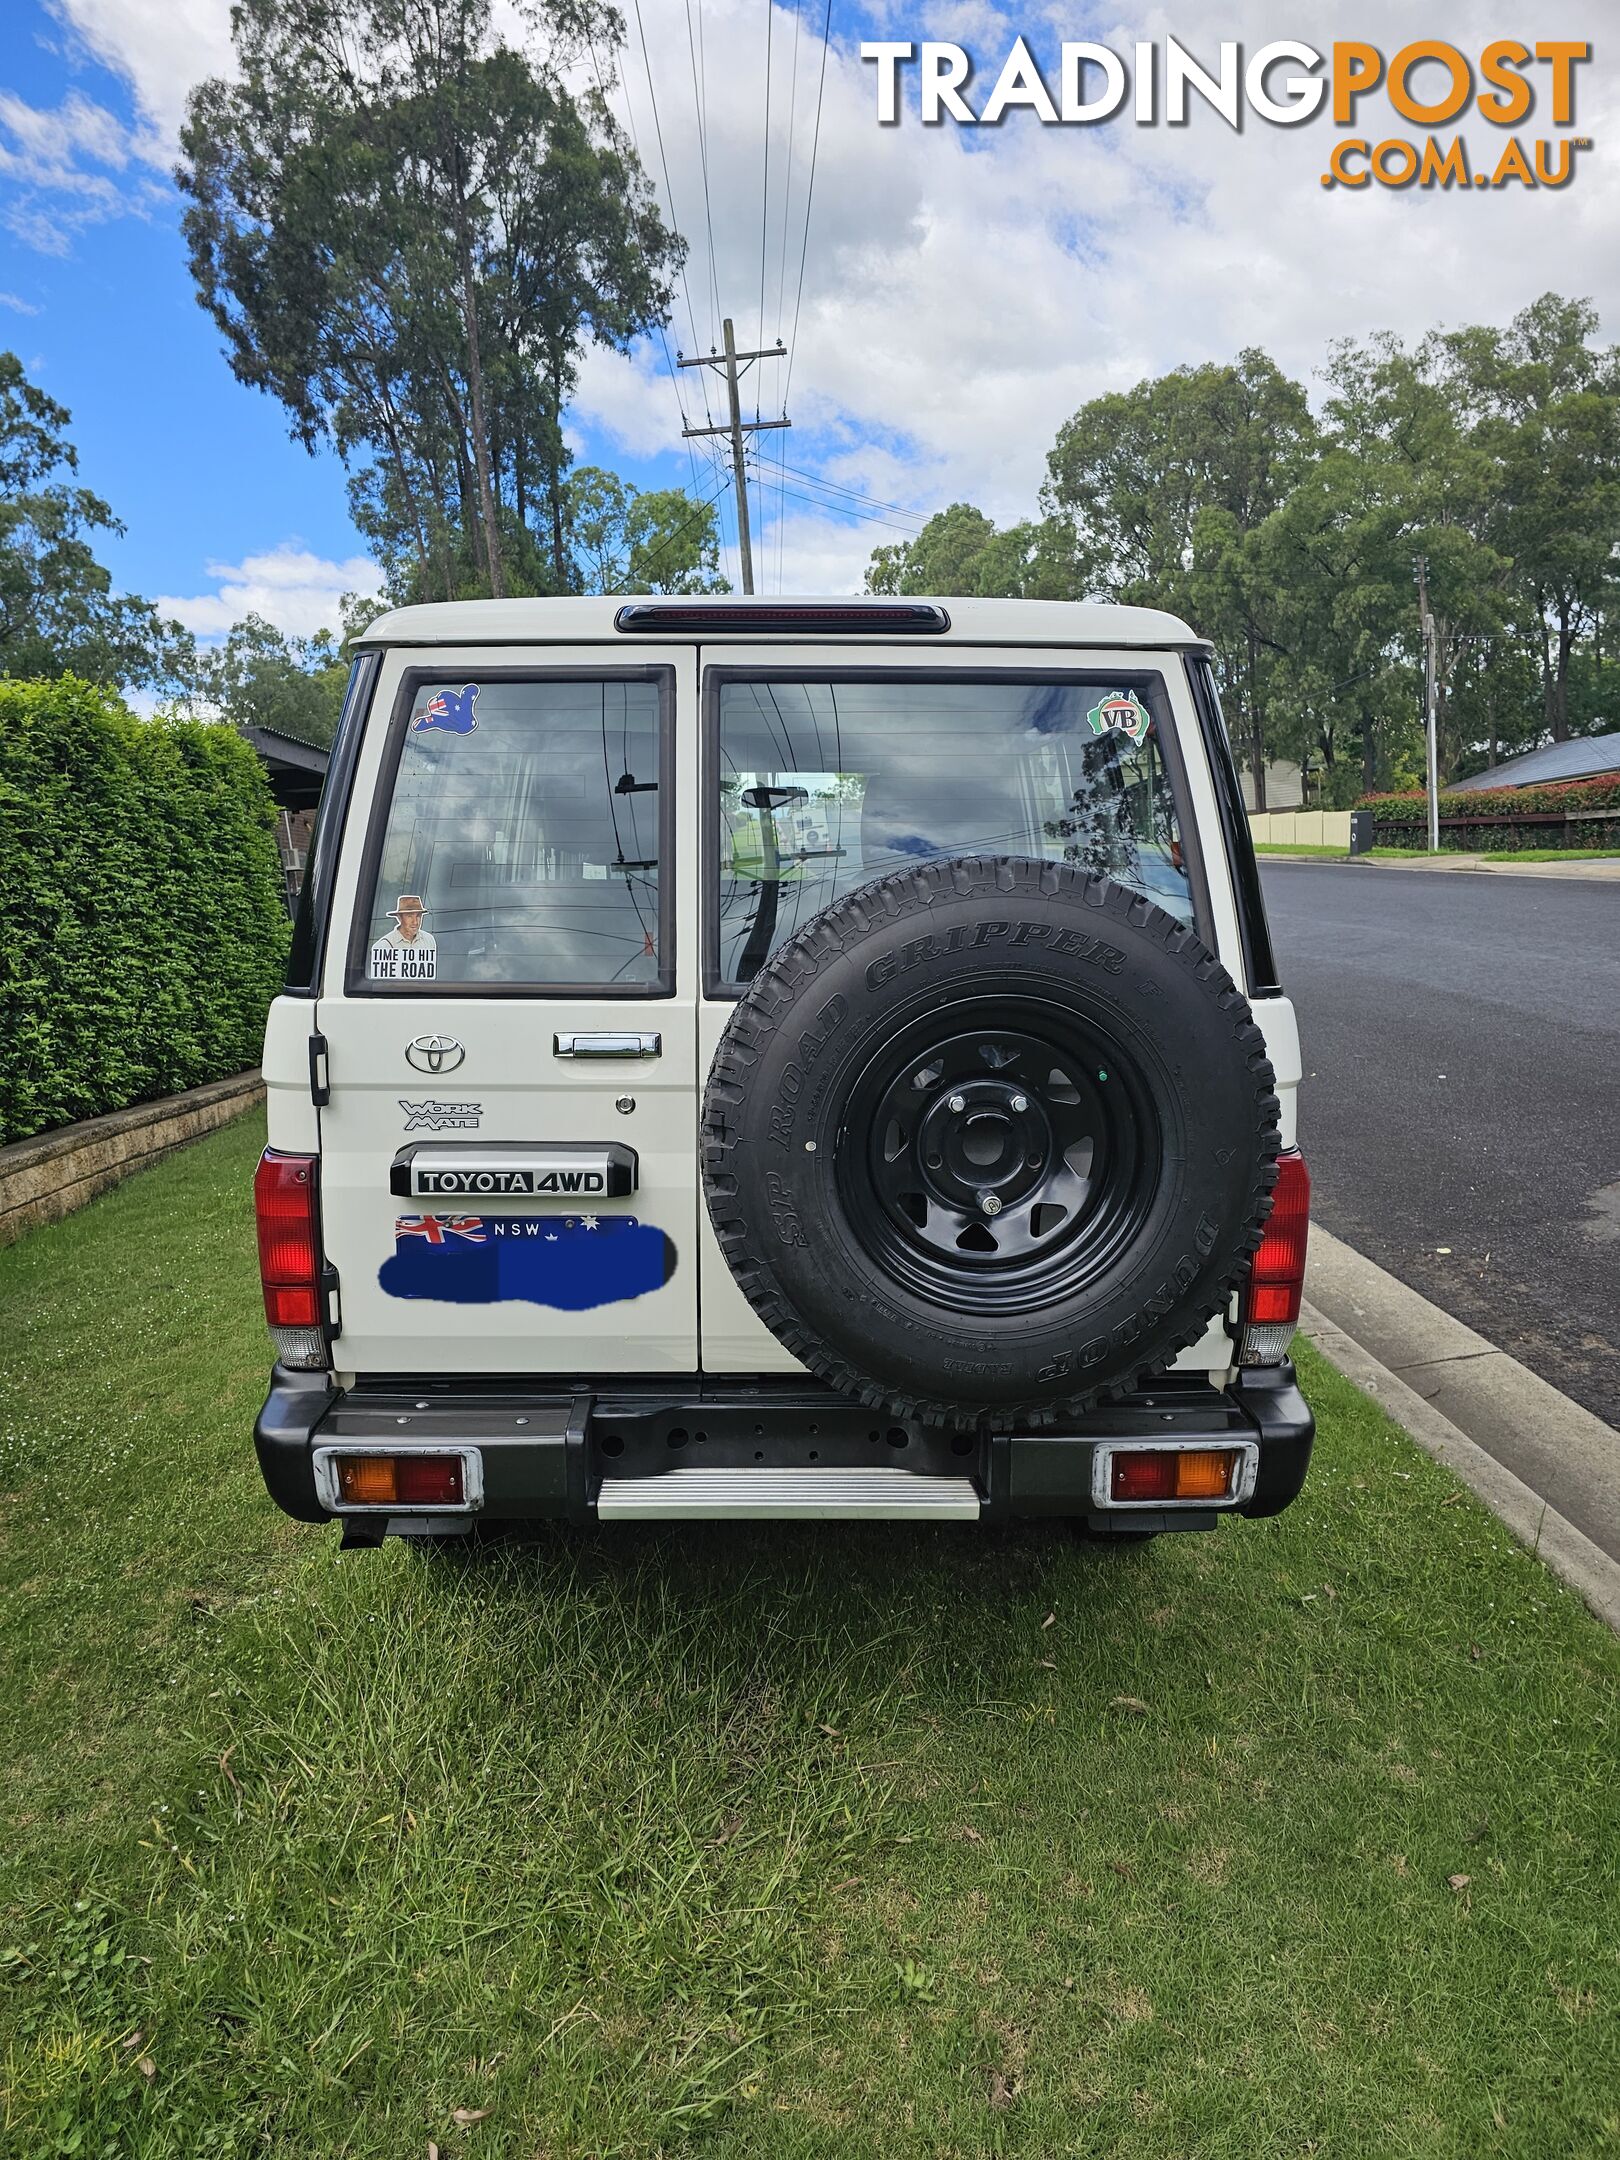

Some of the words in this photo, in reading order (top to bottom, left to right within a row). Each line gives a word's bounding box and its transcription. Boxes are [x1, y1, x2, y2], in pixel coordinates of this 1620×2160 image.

[1101, 708, 1137, 729] VB
[373, 948, 399, 961] TIME
[402, 948, 415, 962] TO
[418, 949, 435, 962] HIT
[372, 962, 396, 977] THE
[401, 962, 435, 978] ROAD
[766, 992, 849, 1152] ROAD
[864, 919, 1128, 993] GRIPPER
[399, 1100, 483, 1115] WORK
[404, 1115, 479, 1130] MATE
[423, 1173, 529, 1192] TOYOTA
[536, 1172, 605, 1192] 4WD
[1033, 1210, 1221, 1384] DUNLOP
